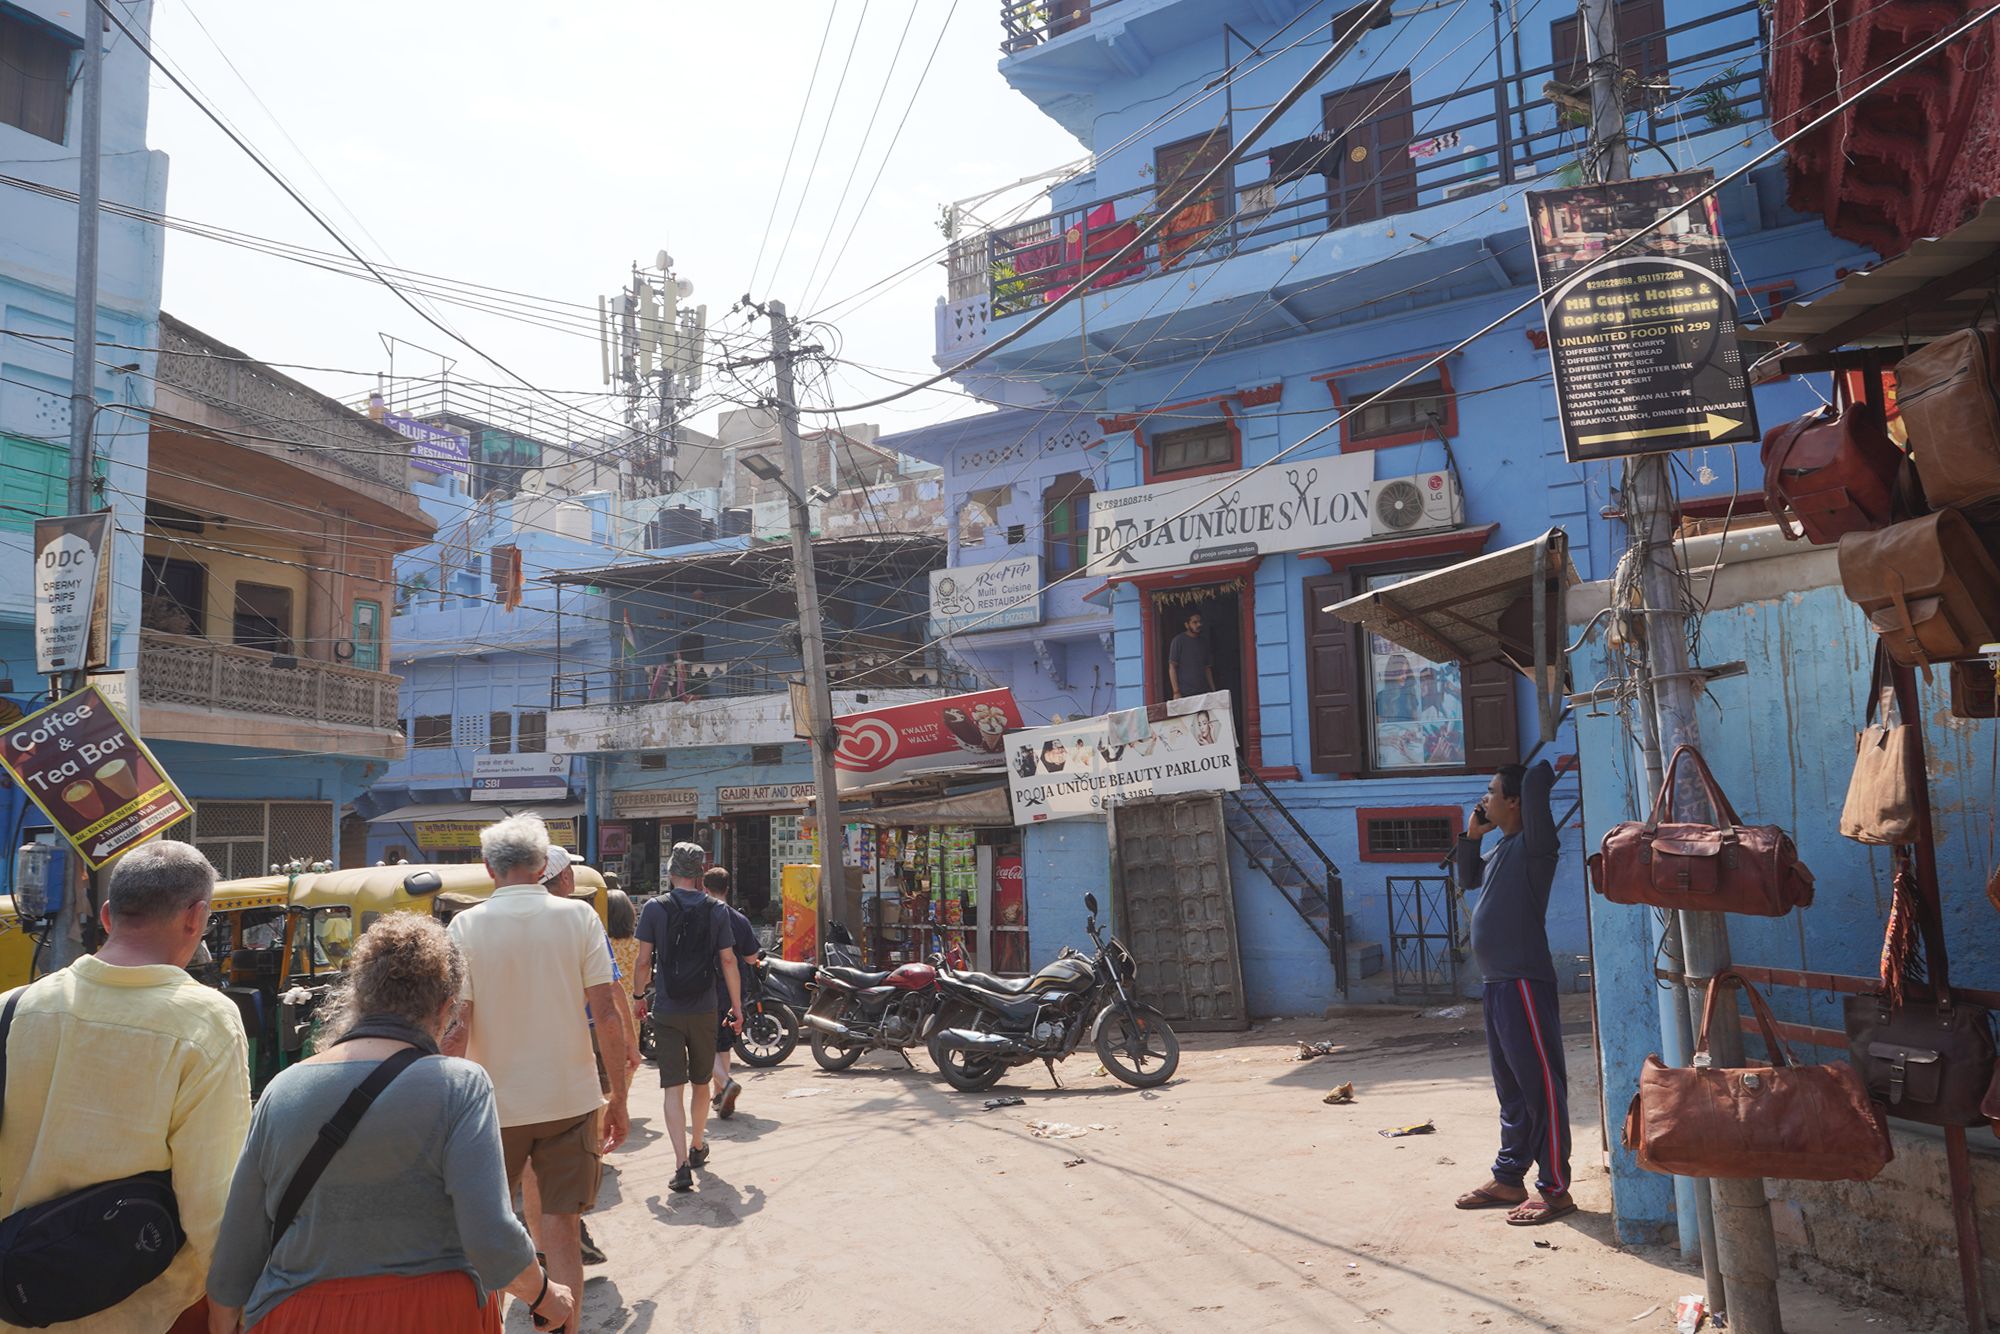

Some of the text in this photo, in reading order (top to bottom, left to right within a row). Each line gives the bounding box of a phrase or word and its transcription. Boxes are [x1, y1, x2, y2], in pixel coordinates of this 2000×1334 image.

[1565, 283, 1710, 310] MH Guest House &
[1563, 299, 1719, 327] Rooftop Restaurant
[1557, 322, 1711, 347] UNLIMITED FOOD IN 299
[1566, 345, 1609, 356] DIFFERENT
[1611, 342, 1631, 350] TYPE
[1632, 339, 1665, 348] CURRYS
[1567, 354, 1611, 365] DIFFERENT
[1613, 351, 1633, 359] TYPE
[1634, 348, 1662, 357] BREAD
[1568, 362, 1612, 373] DIFFERENT
[1614, 360, 1634, 368] TYPE
[1636, 358, 1654, 366] RICE
[1569, 371, 1614, 382] DIFFERENT
[1615, 369, 1636, 377] TYPE
[1637, 365, 1670, 375] BUTTER
[1671, 362, 1693, 370] MILK
[1571, 382, 1592, 391] TIME
[1594, 379, 1620, 388] SERVE
[1621, 376, 1652, 386] DESERT
[1566, 388, 1626, 400] INDIAN SNACK
[1567, 397, 1621, 409] RAJASTHANI,
[1622, 394, 1653, 403] INDIAN
[1671, 388, 1692, 397] TYPE
[1568, 404, 1638, 417] THALI AVAILABLE
[1570, 401, 1748, 427] BREAKFAST, LUNCH, DINNER ALL AVAILABLE
[399, 422, 456, 450] BLUE BIRD
[417, 445, 467, 468] RESTAURANT
[1430, 492, 1443, 501] LG
[1179, 502, 1275, 542] UNIQUE
[1278, 488, 1371, 531] SALON
[45, 549, 85, 568] DDC
[1200, 551, 1217, 560] pooja
[43, 579, 82, 591] DREAMY
[978, 583, 1032, 598] Multi Cuisine
[48, 592, 76, 603] DRIPS
[978, 594, 1032, 609] RESTAURANT
[50, 604, 73, 614] CAFE
[12, 704, 93, 752] Coffee
[901, 723, 938, 735] KWALITY
[58, 737, 74, 751] &
[907, 733, 938, 743] WALL'S
[28, 732, 125, 791] Tea Bar
[484, 779, 500, 788] SBI
[1015, 783, 1054, 803] POOJA
[1057, 776, 1107, 796] UNIQUE
[1109, 766, 1163, 788] BEAUTY
[1165, 754, 1232, 778] PARLOUR
[721, 787, 750, 800] GAURI
[753, 786, 770, 798] ART
[771, 785, 788, 798] AND
[104, 819, 128, 837] Minute
[137, 802, 155, 817] Walk
[551, 821, 571, 830] TRAVELS
